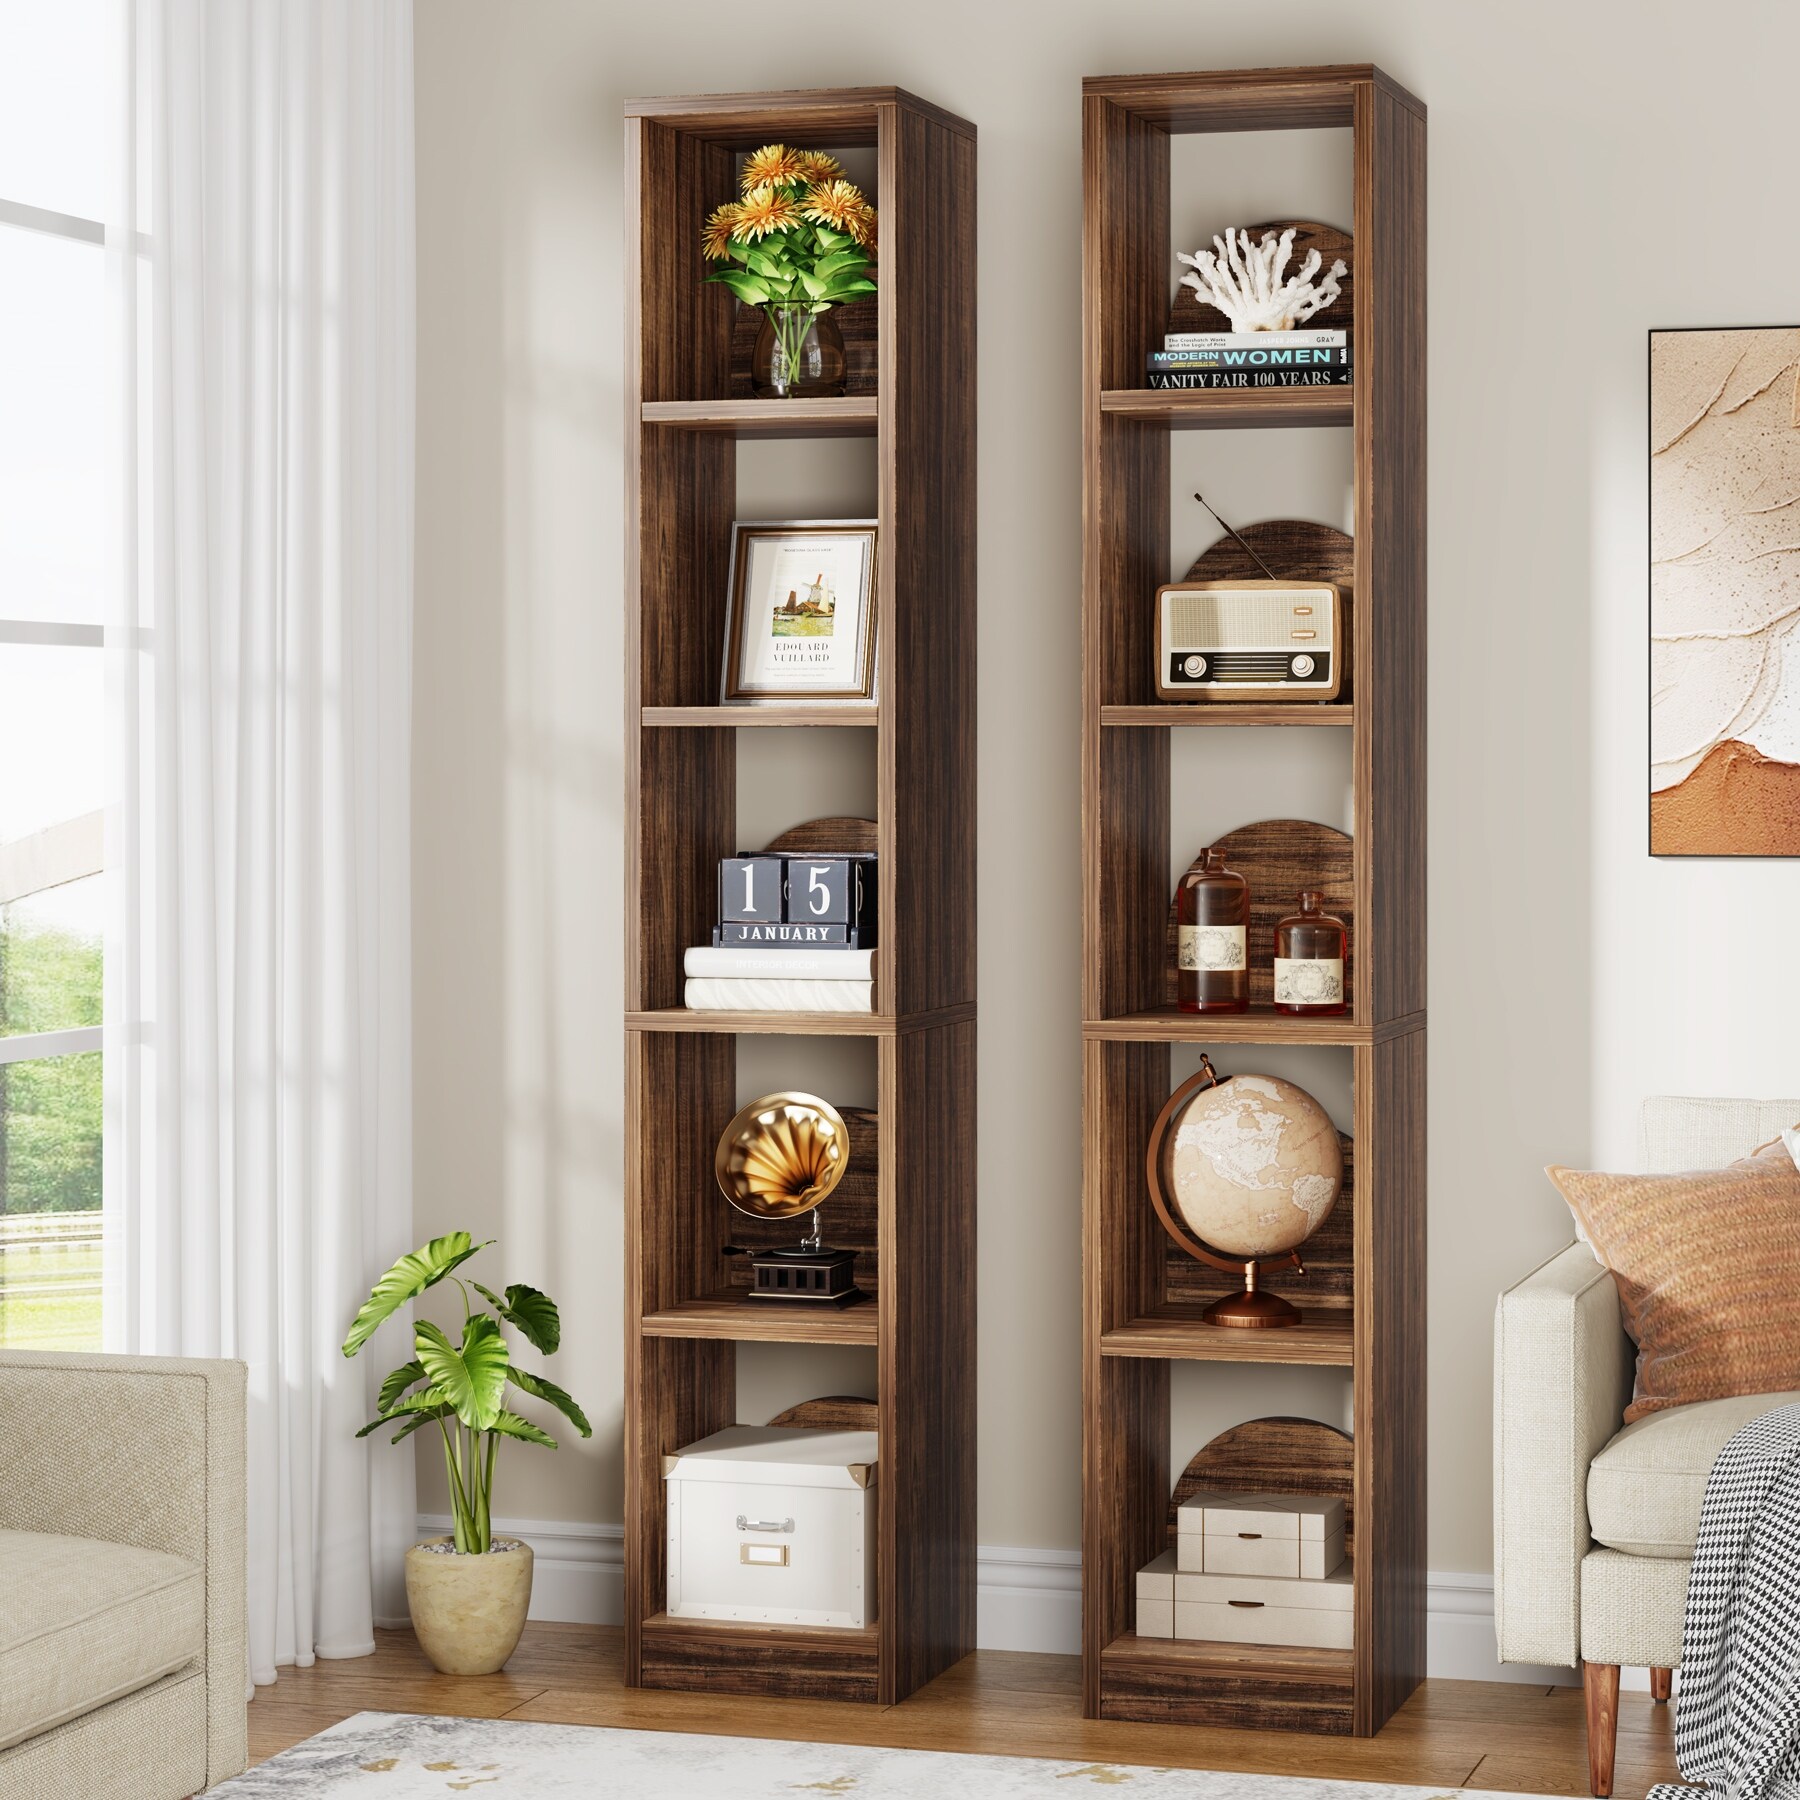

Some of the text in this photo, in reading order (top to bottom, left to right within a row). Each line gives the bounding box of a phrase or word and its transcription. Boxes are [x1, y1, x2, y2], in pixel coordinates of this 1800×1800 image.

[1154, 349, 1331, 365] MODERN WOMEN
[1149, 373, 1208, 389] VANITY
[1212, 372, 1248, 388] FAIR
[1253, 371, 1275, 387] 100
[1279, 371, 1331, 385] YEARS
[775, 643, 829, 651] EDOUARD
[773, 654, 830, 662] VUILLARD
[741, 863, 757, 912] 1
[808, 866, 831, 915] 5
[738, 926, 830, 941] JANUARY
[736, 959, 819, 969] INTERIOR DECOR
